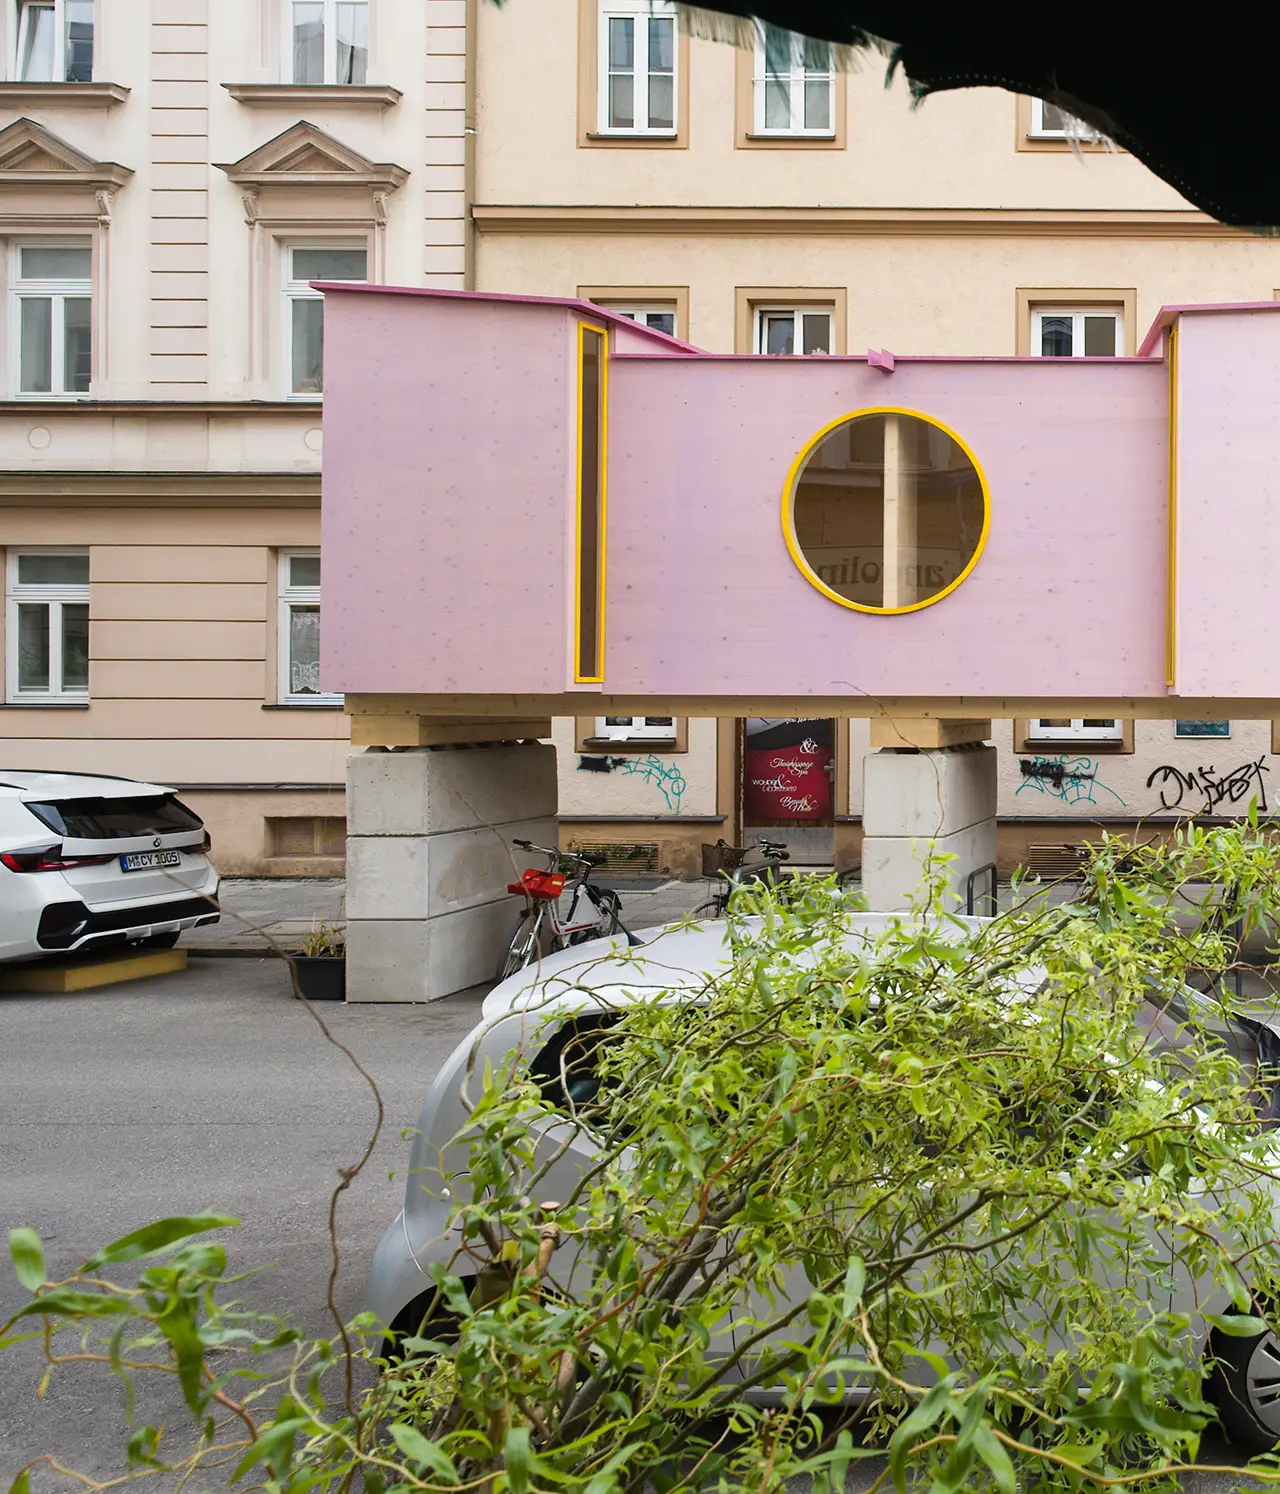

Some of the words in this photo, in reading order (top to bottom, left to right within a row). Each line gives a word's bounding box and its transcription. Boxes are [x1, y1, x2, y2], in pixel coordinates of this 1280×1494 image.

[128, 856, 136, 868] M
[141, 855, 153, 866] CY
[155, 851, 178, 865] 1005
